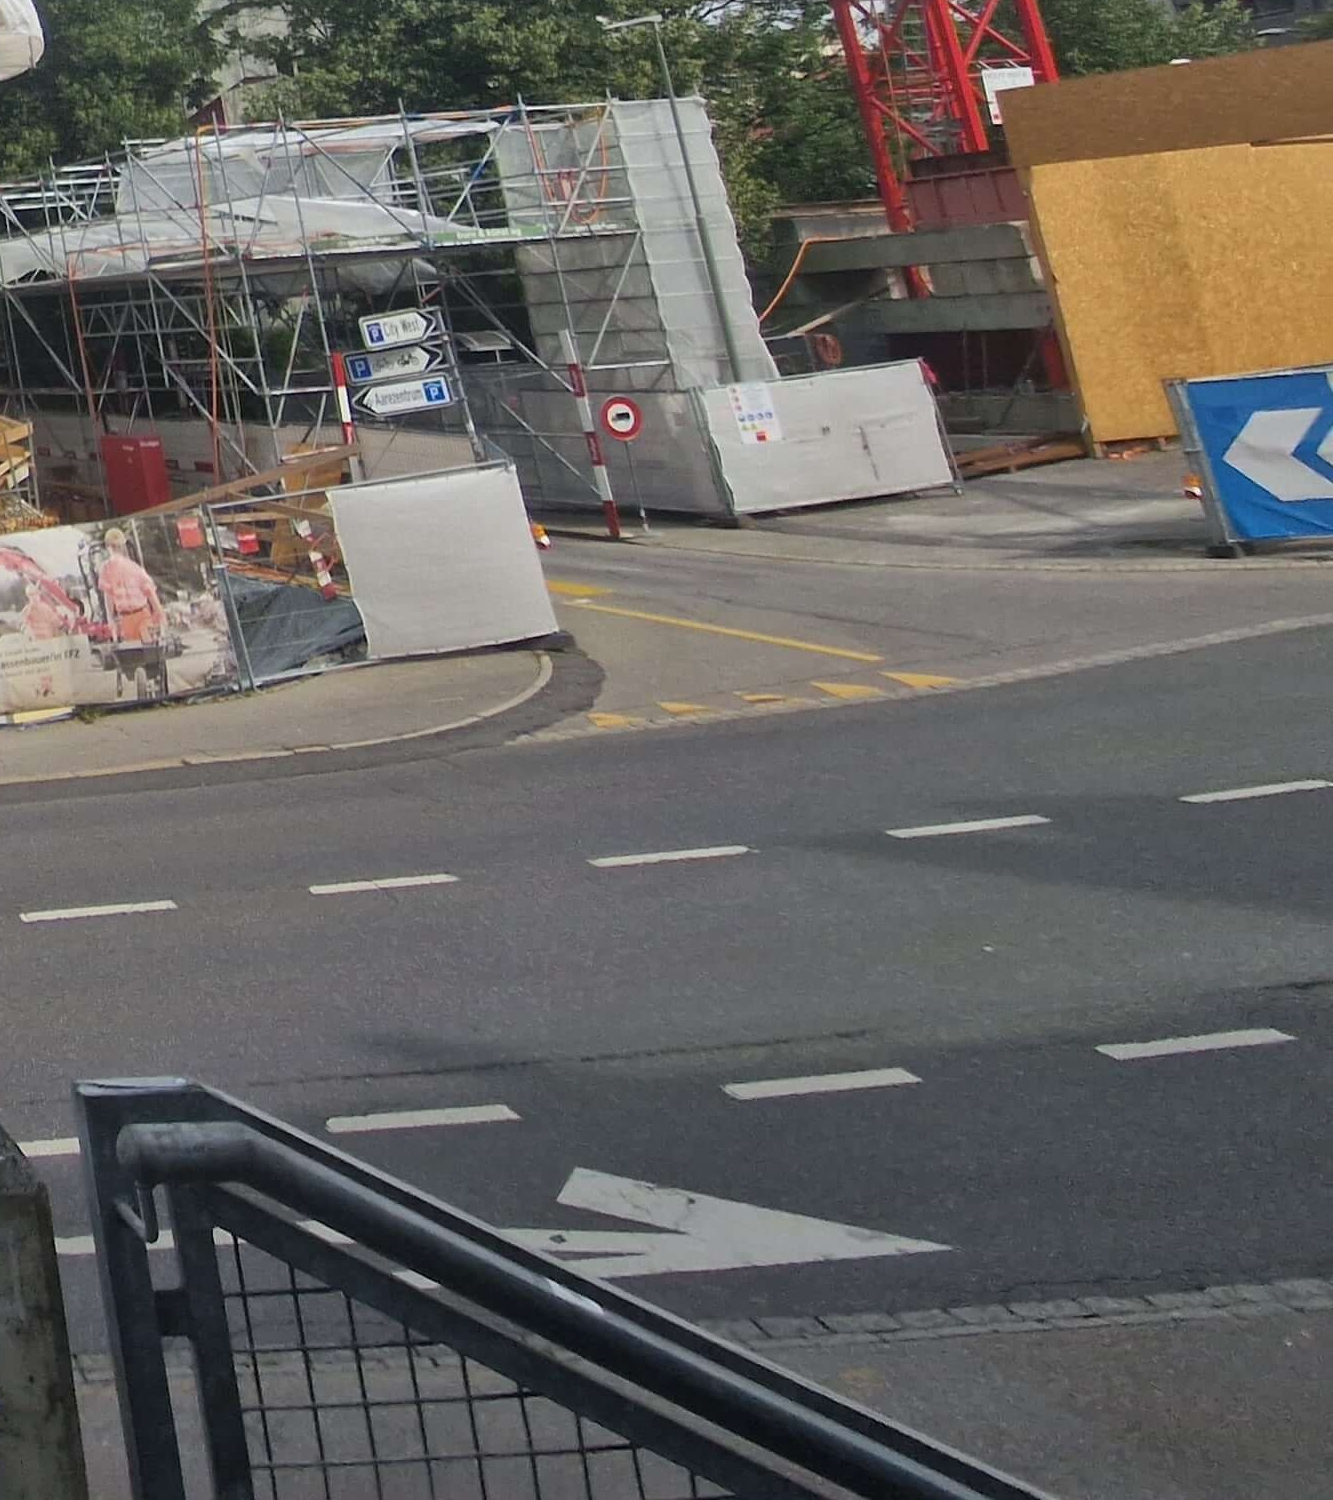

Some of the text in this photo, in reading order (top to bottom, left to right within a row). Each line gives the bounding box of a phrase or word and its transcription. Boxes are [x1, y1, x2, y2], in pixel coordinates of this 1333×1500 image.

[384, 321, 399, 337] City
[399, 317, 422, 333] West
[375, 388, 422, 405] Aarezentrum
